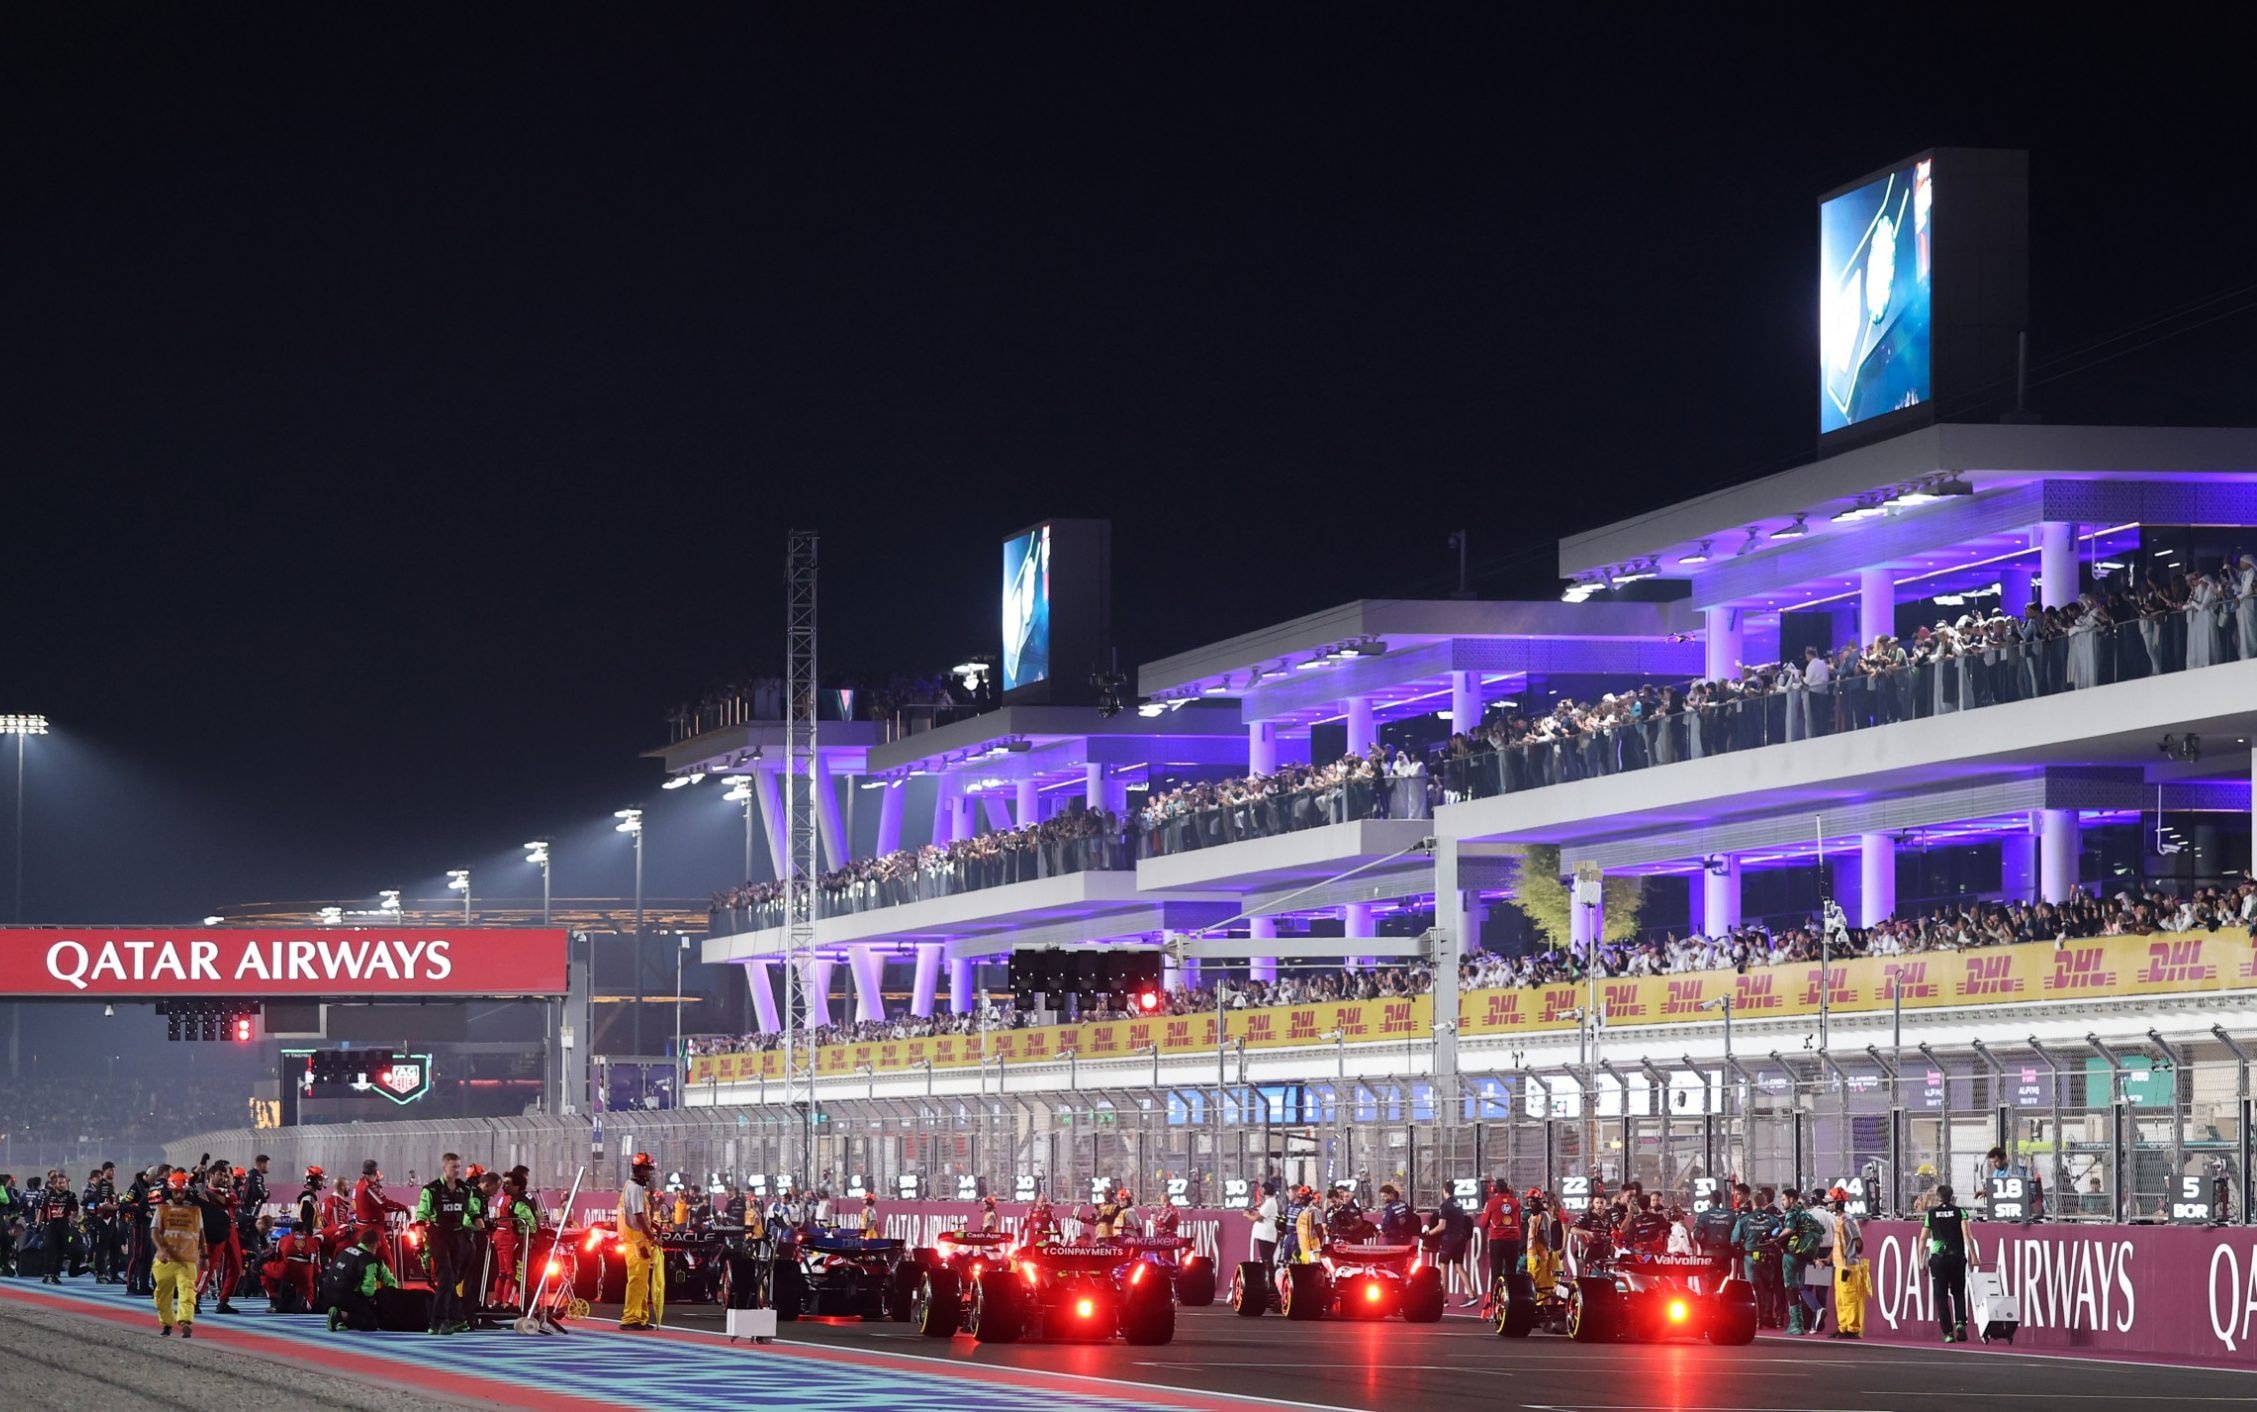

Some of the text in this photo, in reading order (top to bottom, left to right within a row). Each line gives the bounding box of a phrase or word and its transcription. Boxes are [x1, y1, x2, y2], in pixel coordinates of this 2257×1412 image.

[46, 940, 452, 989] QATAR AIRWAYS
[2054, 948, 2106, 989] DHL
[2149, 940, 2205, 982] DHL
[1807, 968, 1849, 1005] DHL
[1883, 962, 1929, 999] DHL
[1966, 955, 2014, 995] DHL
[1605, 985, 1639, 1017] DHL
[1668, 980, 1706, 1013] DHL
[1735, 974, 1775, 1009] DHL
[1384, 1004, 1413, 1032] DHL
[1488, 994, 1519, 1025] DHL
[1544, 990, 1577, 1022] DHL
[1247, 1015, 1272, 1041] DHL
[1290, 1011, 1317, 1038] DHL
[1336, 1007, 1363, 1035] DHL
[1027, 1033, 1046, 1056] DHL
[1060, 1030, 1080, 1053] DHL
[1094, 1028, 1114, 1051] DHL
[1130, 1024, 1151, 1049] DHL
[1167, 1022, 1190, 1047] DHL
[1168, 1179, 1189, 1194] 27
[1225, 1180, 1248, 1195] 30
[1453, 1179, 1477, 1196] 23
[1562, 1176, 1588, 1195] 22
[1992, 1179, 2023, 1199] 18
[2182, 1176, 2200, 1198] 5
[1225, 1197, 1249, 1208] LAW
[1562, 1197, 1589, 1210] TSU
[1994, 1203, 2021, 1218] STR
[2172, 1203, 2208, 1218] BOR
[885, 1213, 921, 1251] QATAR
[966, 1231, 1001, 1241] Cash App
[1136, 1236, 1180, 1247] kraken
[1049, 1246, 1124, 1257] COINPAYMENTS
[1654, 1254, 1713, 1267] Valvoline
[1996, 1238, 2135, 1333] AIRWAYS
